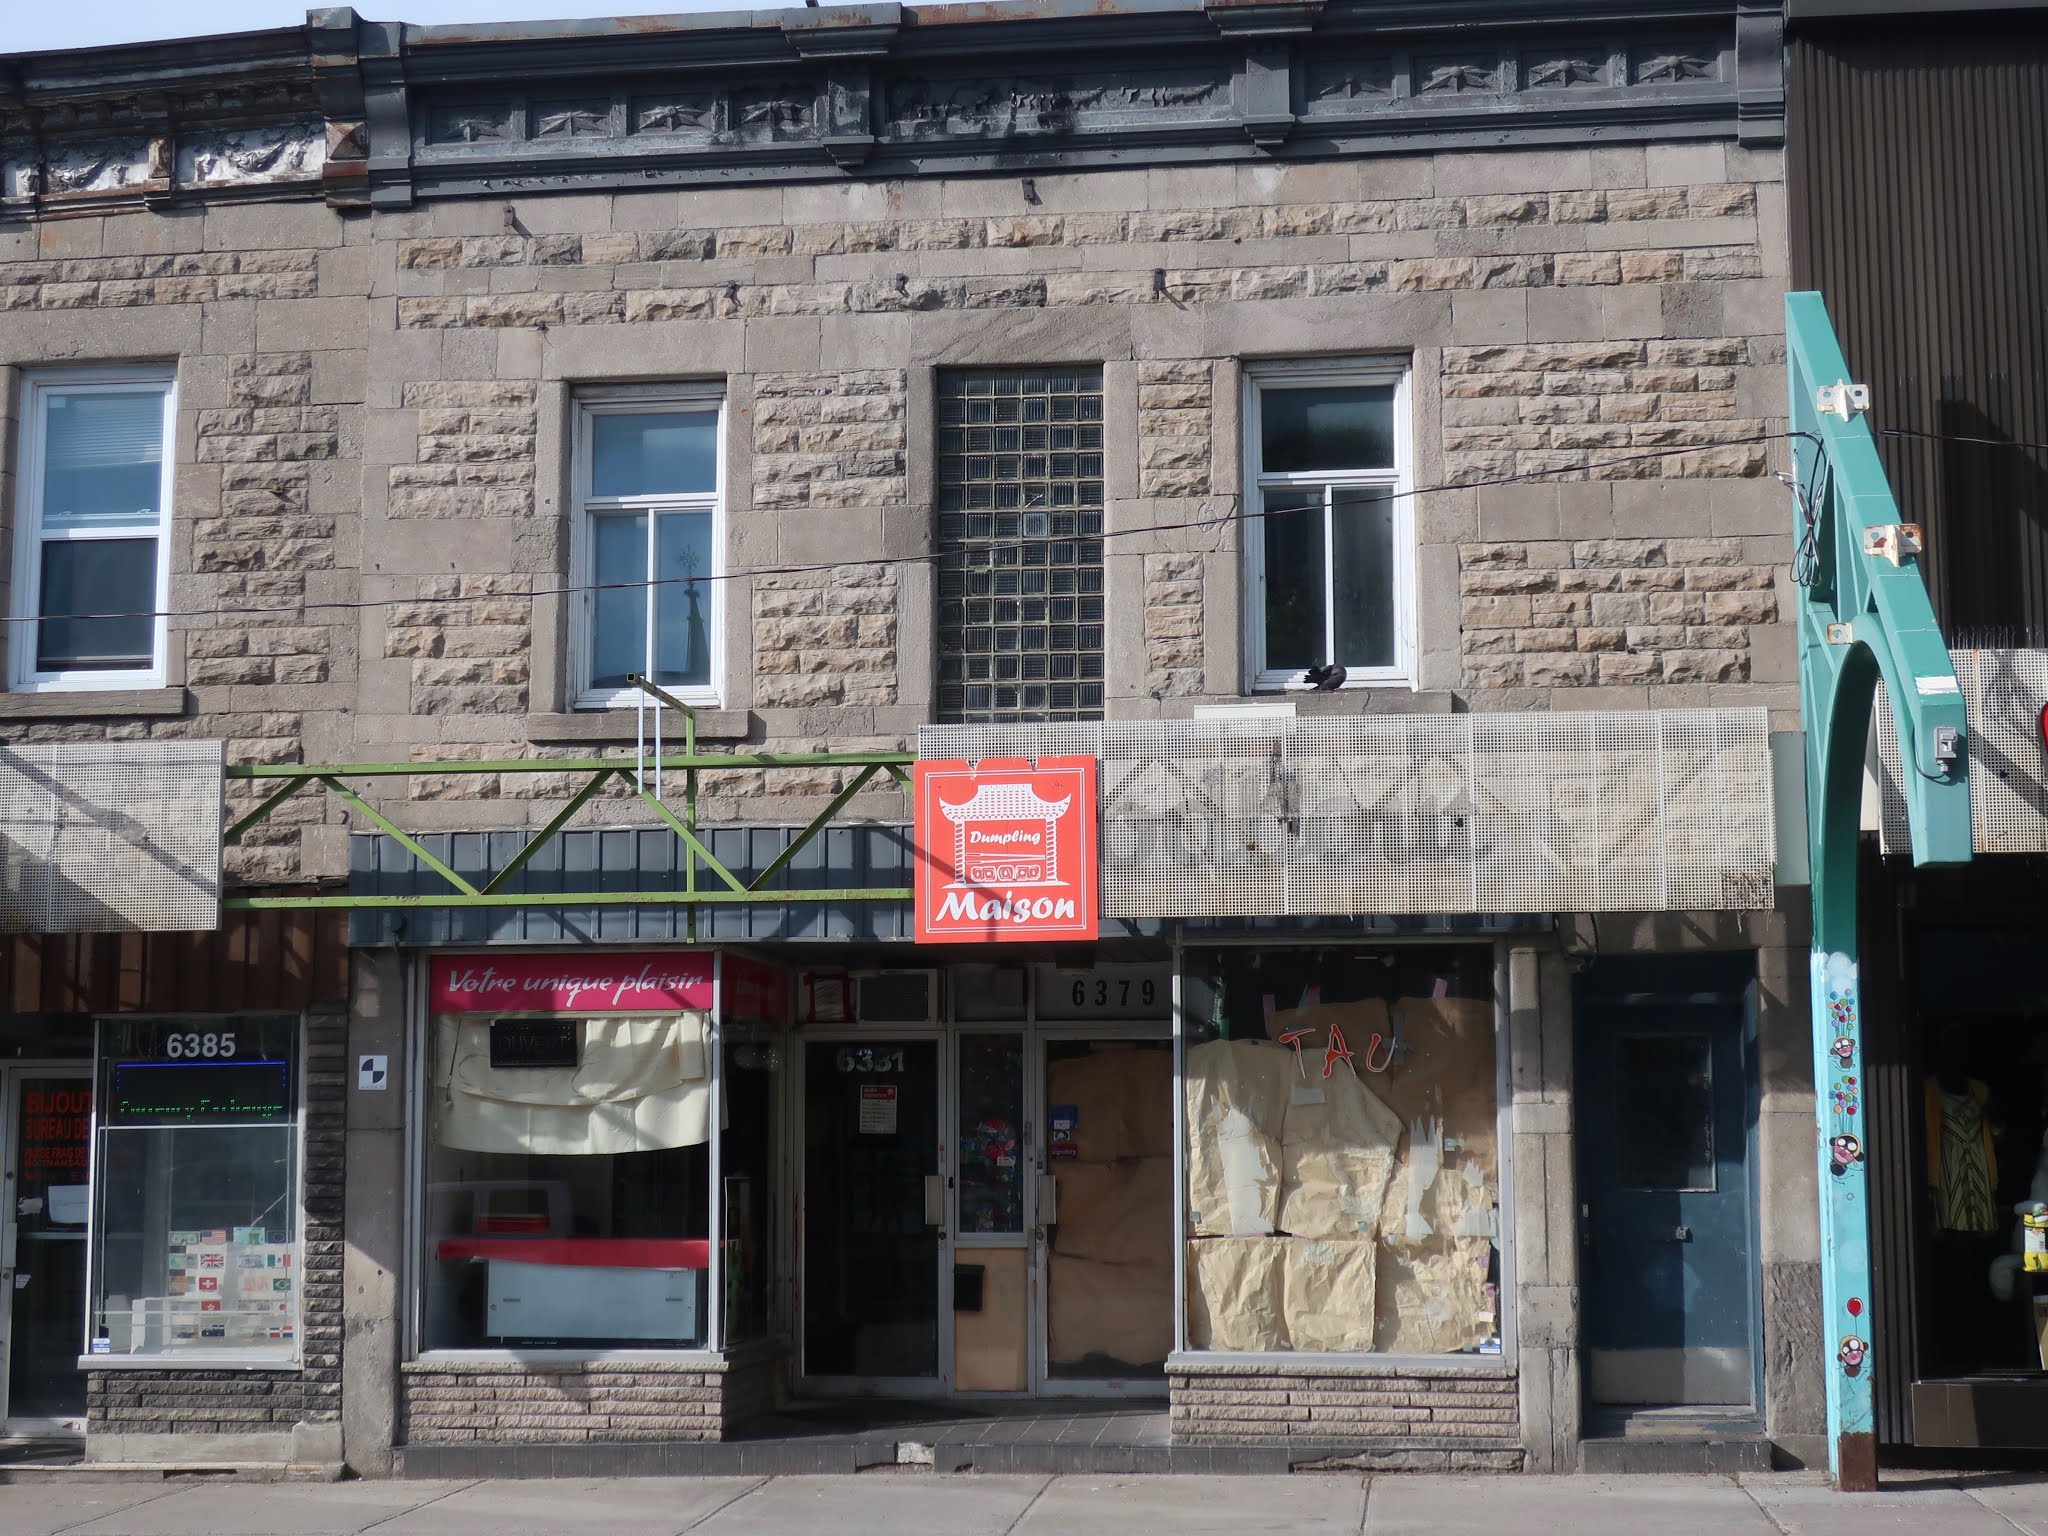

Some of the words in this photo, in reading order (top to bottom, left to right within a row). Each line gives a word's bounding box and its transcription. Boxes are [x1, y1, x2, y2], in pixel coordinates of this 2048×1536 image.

[969, 829, 1041, 845] Dumpling
[935, 890, 1076, 924] Maison
[449, 966, 515, 993] Votre
[523, 974, 614, 1008] unique
[611, 963, 703, 1006] plaisir
[1071, 979, 1156, 1007] 6379
[166, 1033, 236, 1058] 6385
[1279, 1023, 1396, 1079] TAU
[26, 1090, 92, 1113] BIJOUT
